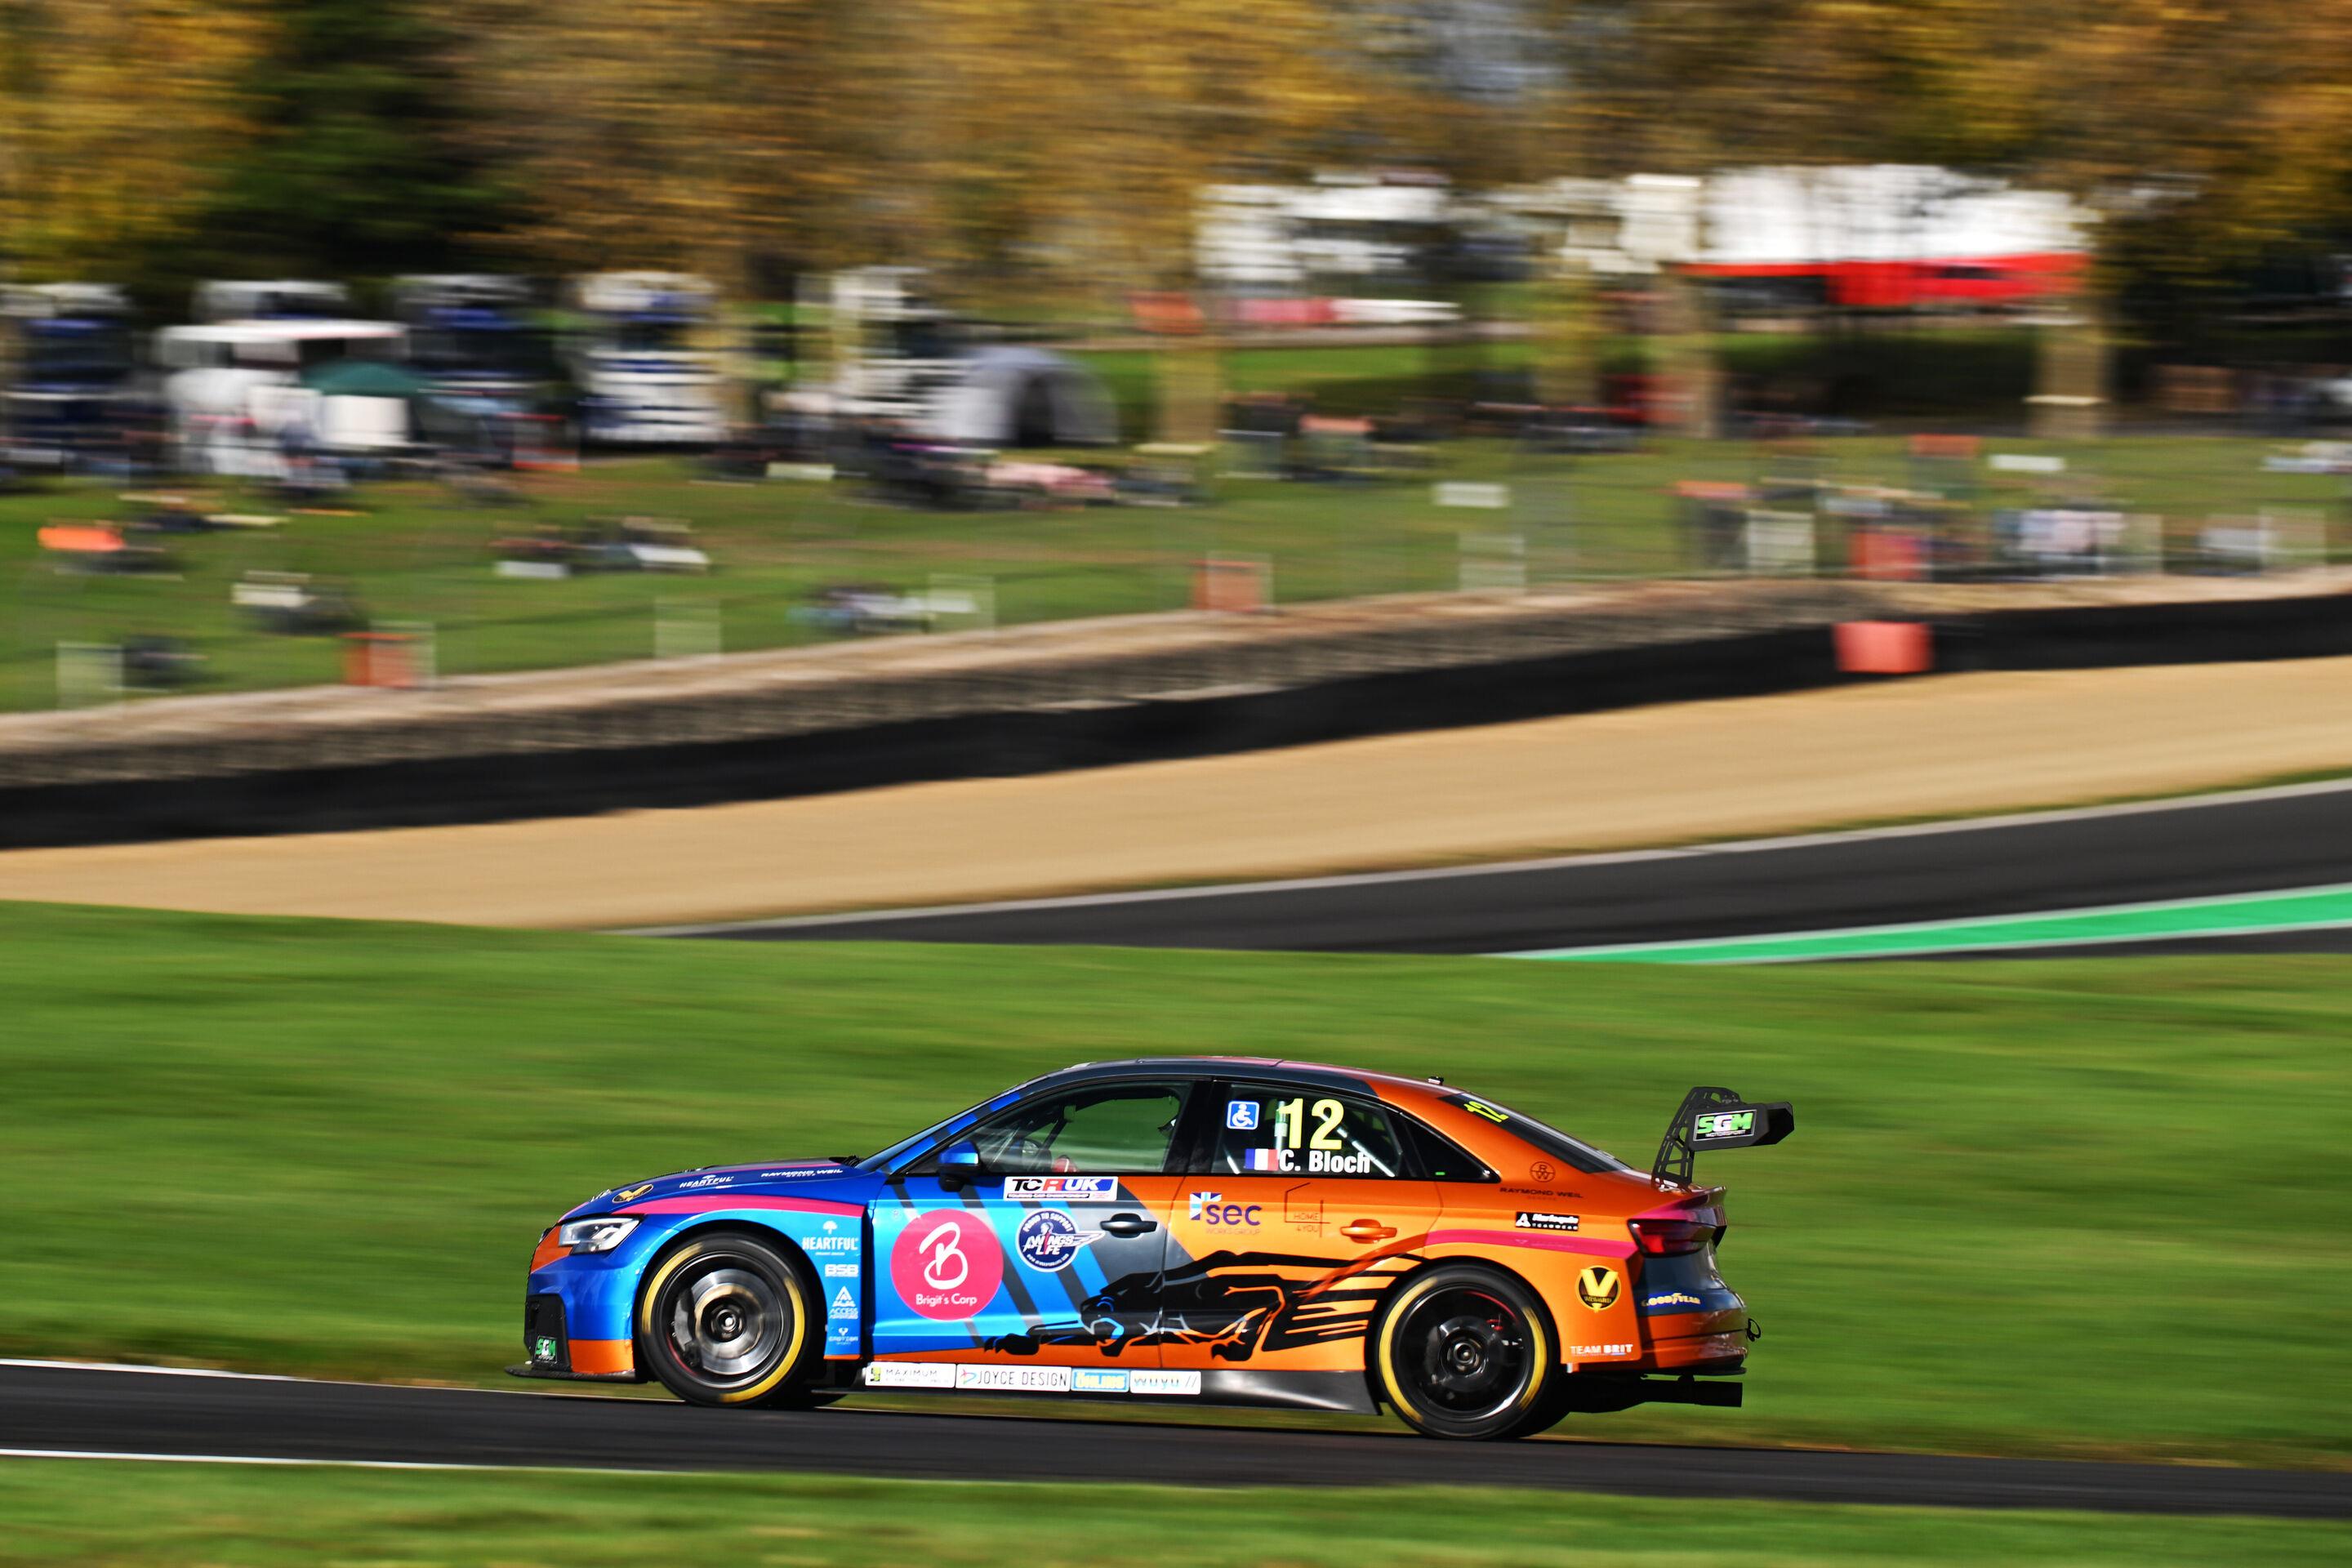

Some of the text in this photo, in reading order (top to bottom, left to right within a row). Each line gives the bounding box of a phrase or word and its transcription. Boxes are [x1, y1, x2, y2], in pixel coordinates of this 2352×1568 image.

[1463, 1101, 1509, 1123] 12
[1279, 1098, 1344, 1150] 12
[1696, 1112, 1753, 1134] SGM
[1279, 1149, 1370, 1174] C. Bloch
[679, 1176, 732, 1189] HEARTFUL
[1500, 1187, 1553, 1196] RAYMOND
[1050, 1213, 1074, 1232] SUPPORT
[1206, 1205, 1263, 1226] sec
[1294, 1213, 1319, 1221] HOME
[802, 1237, 858, 1250] HEARTFUL
[825, 1264, 858, 1275] BSB
[915, 1293, 978, 1307] Brigit's Corp
[536, 1339, 556, 1356] SGM
[1569, 1344, 1633, 1354] TEAM BRIT
[886, 1369, 938, 1377] MAXIMUM
[978, 1371, 1067, 1386] JOYCE DESIGN
